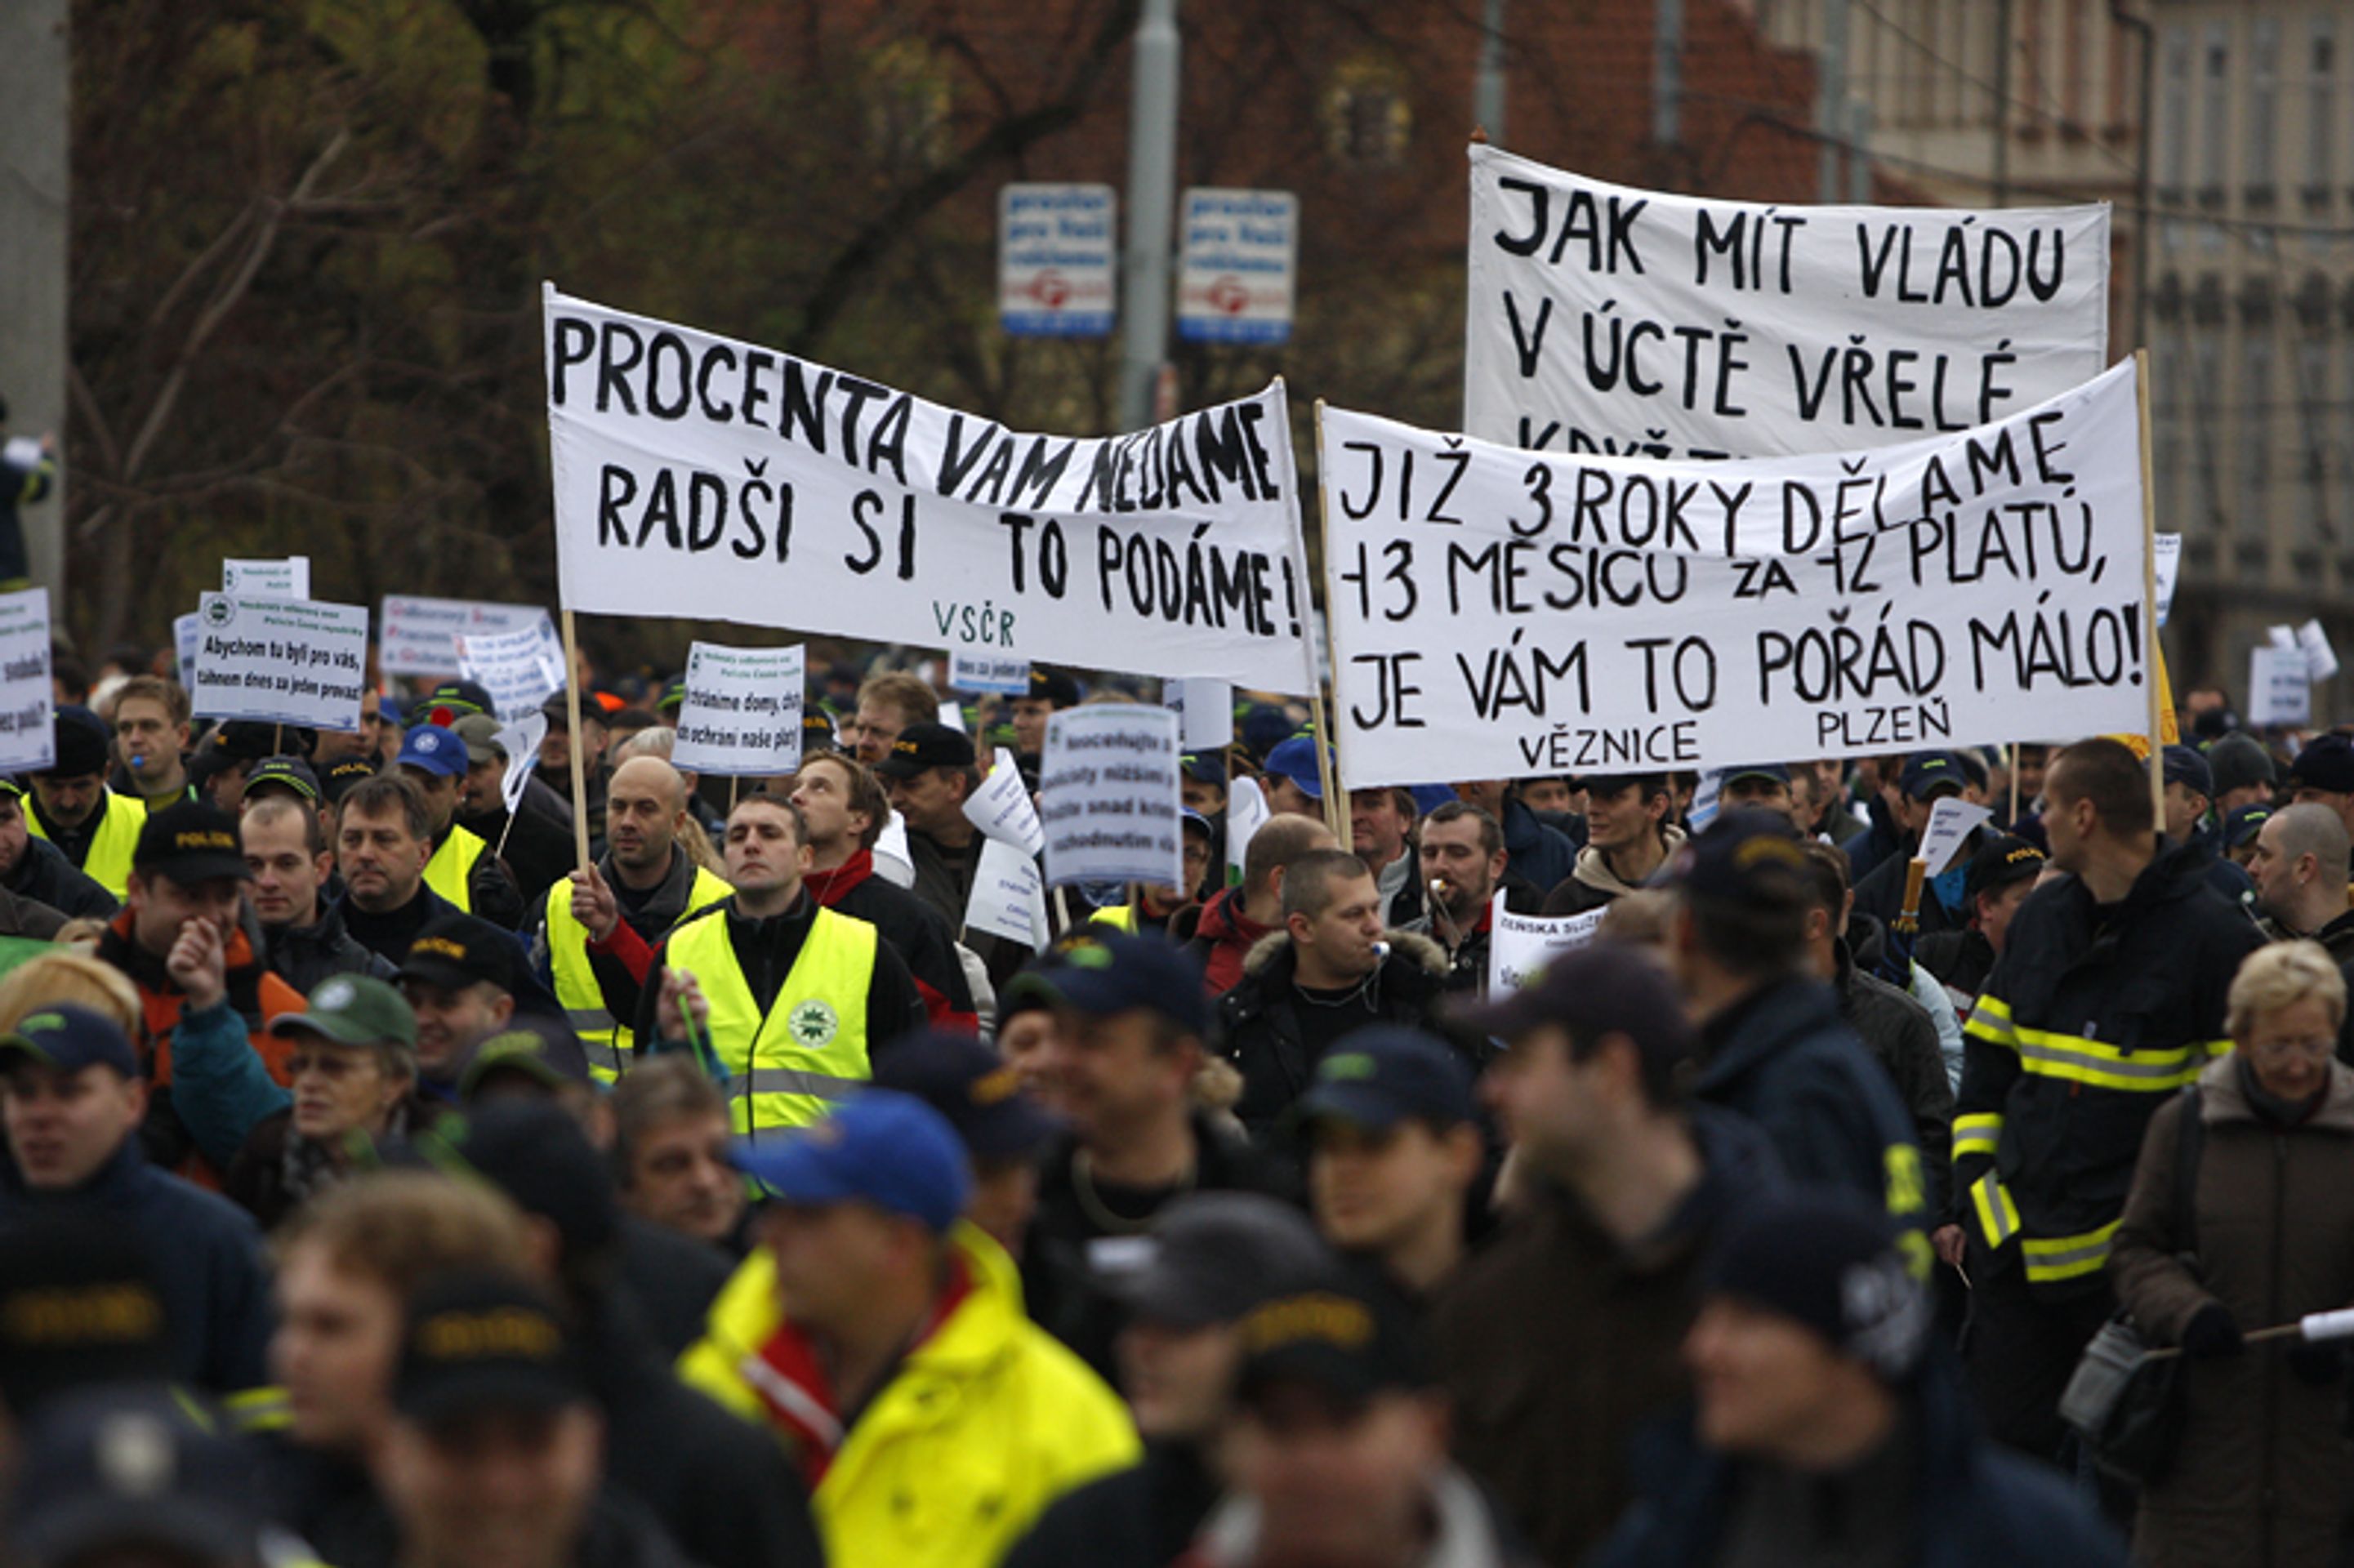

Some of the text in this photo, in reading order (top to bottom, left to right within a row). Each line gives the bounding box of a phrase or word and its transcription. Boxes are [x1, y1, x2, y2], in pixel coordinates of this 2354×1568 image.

[1494, 176, 2064, 310] JAK MÍT VLÁDU
[552, 318, 915, 484] PROCENTA
[1502, 290, 2017, 431] V ÚCTĚ VŘELÉ
[599, 458, 1302, 639] RADŠI SI TO PODÁME!
[1340, 438, 1471, 525] JIŽ
[1572, 466, 1753, 558] ROKY
[204, 635, 265, 660] Abychom
[270, 641, 283, 658] tu
[310, 648, 330, 667] pro
[934, 600, 1014, 646] VSČR
[1351, 590, 2142, 730] JE VÁM TO POŘÁD MÁLO!
[1518, 697, 1951, 768] VĚZNICE PLZEŇ
